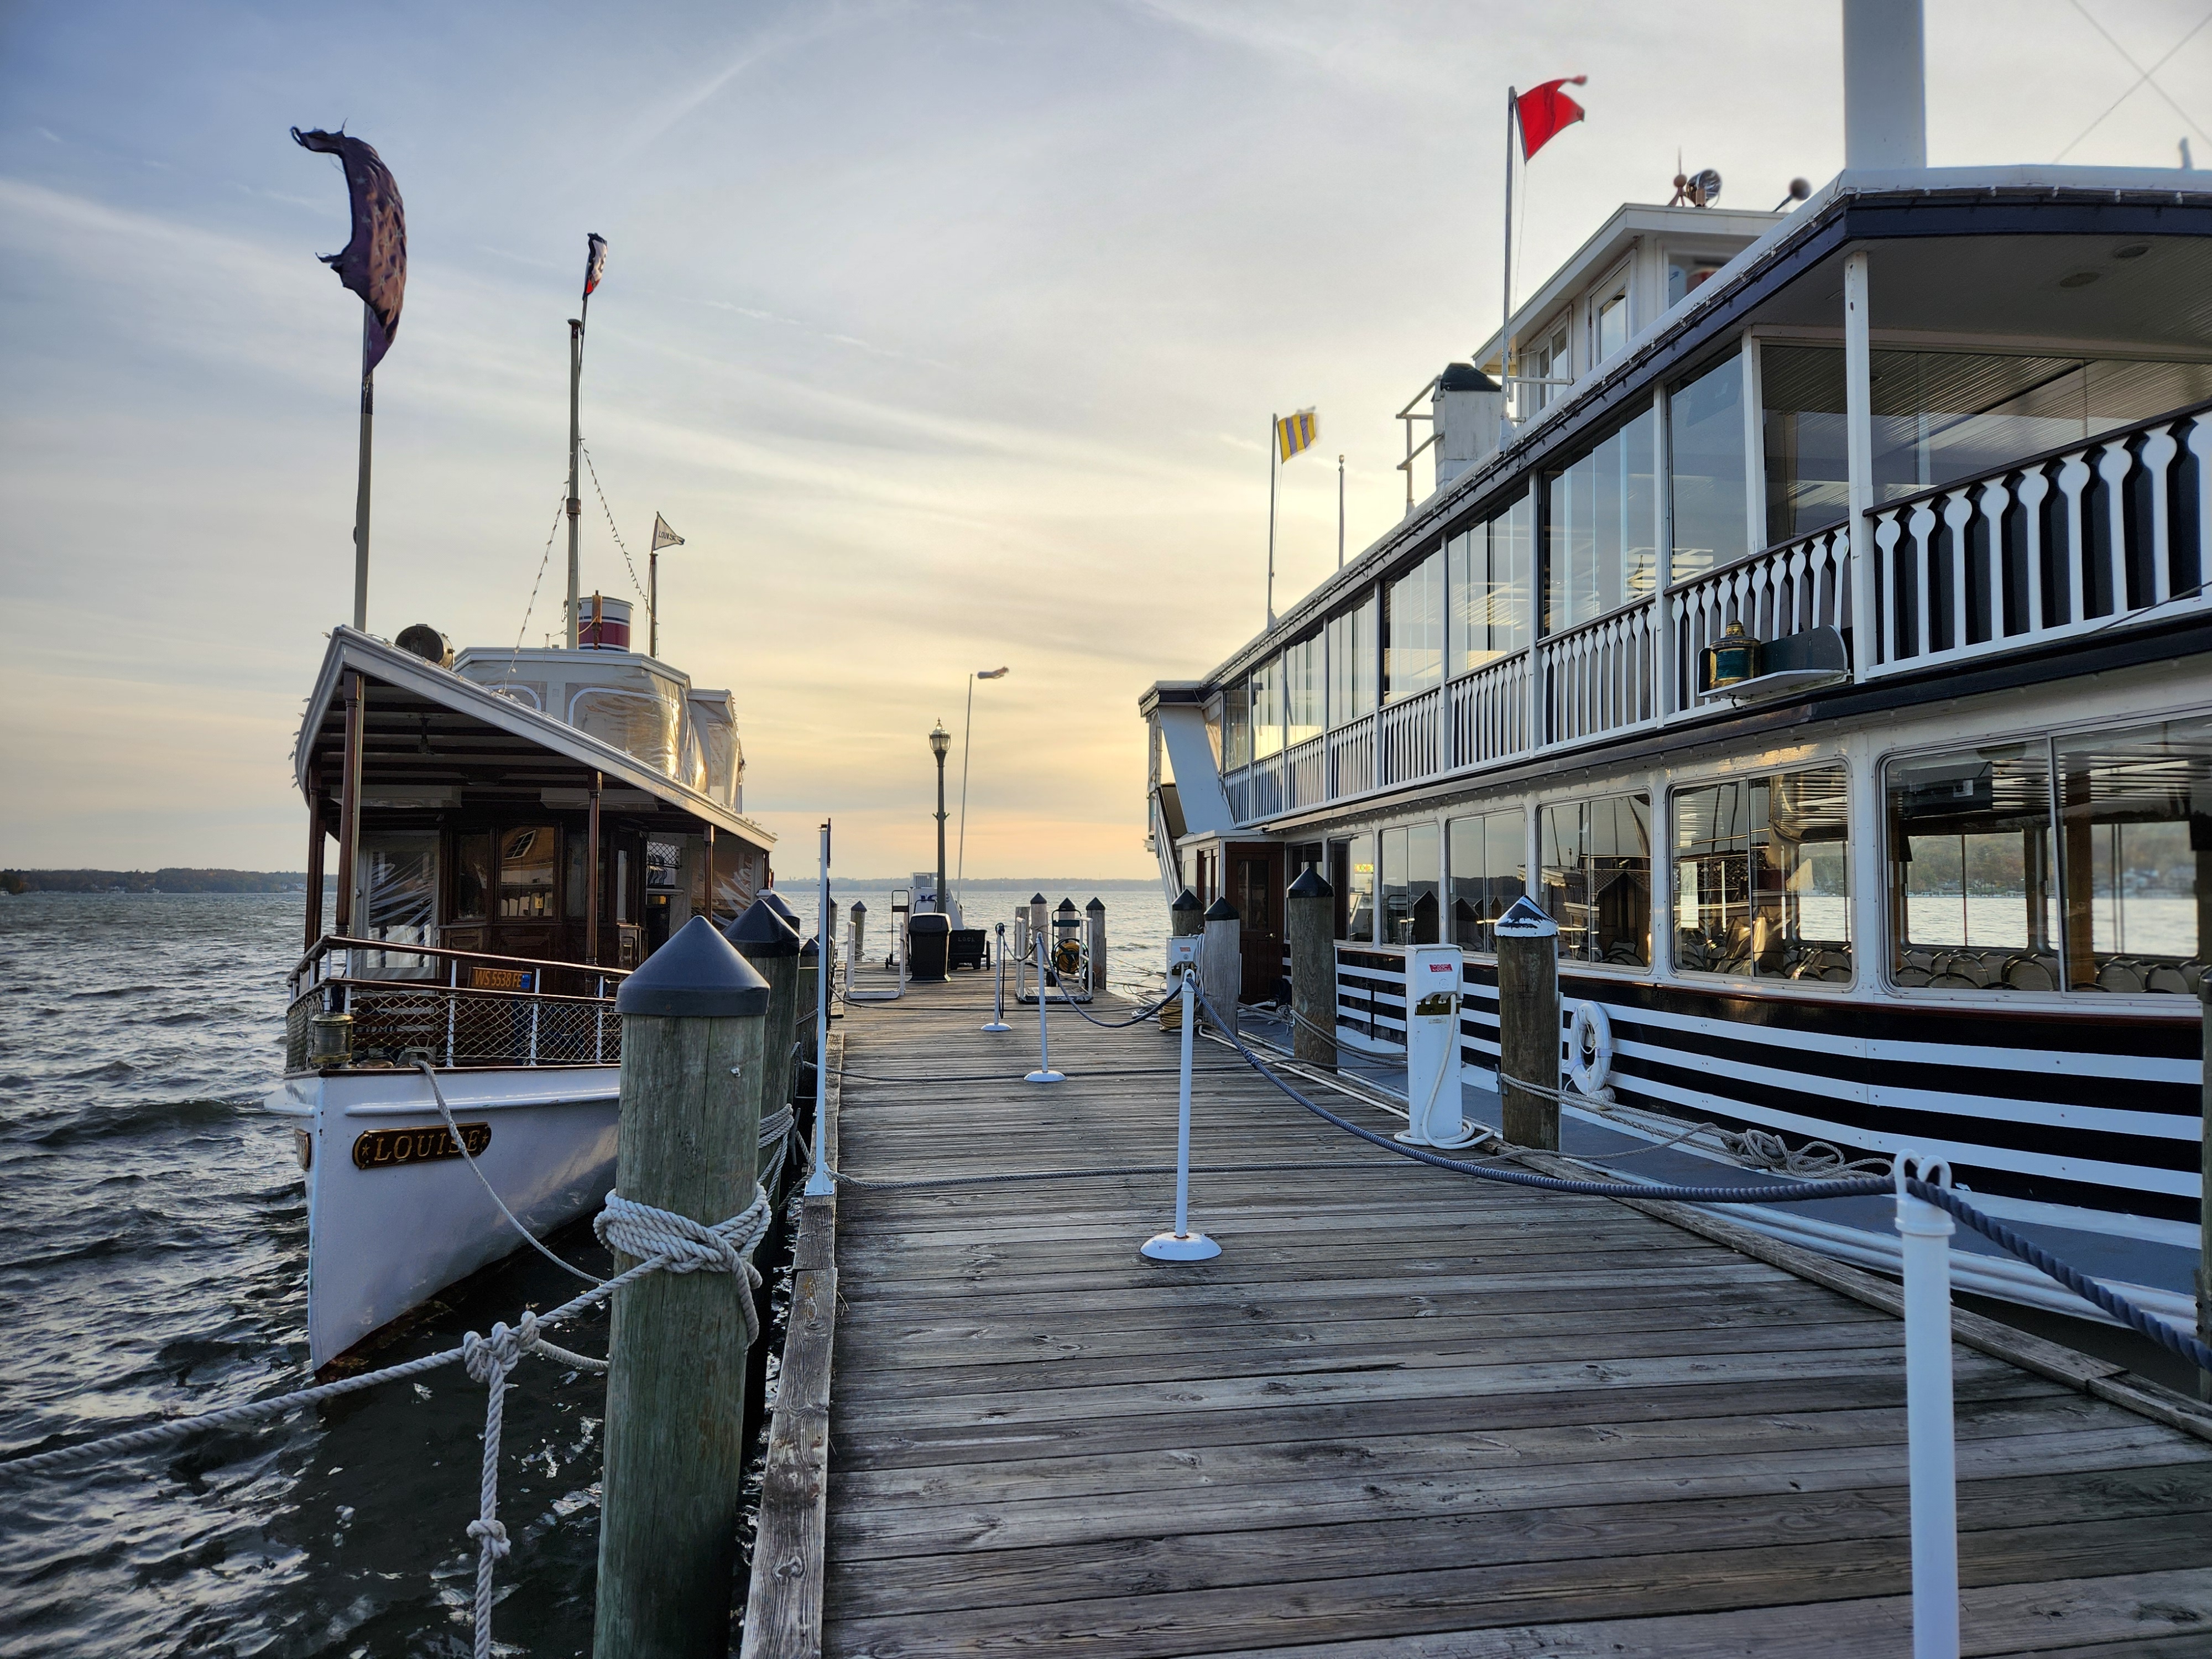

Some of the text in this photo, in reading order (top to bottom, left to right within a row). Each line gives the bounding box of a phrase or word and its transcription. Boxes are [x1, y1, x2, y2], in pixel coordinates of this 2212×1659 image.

[658, 530, 677, 542] LOUISE
[475, 969, 491, 985] WS
[491, 972, 512, 987] 5538
[374, 1130, 481, 1161] LOUISE
